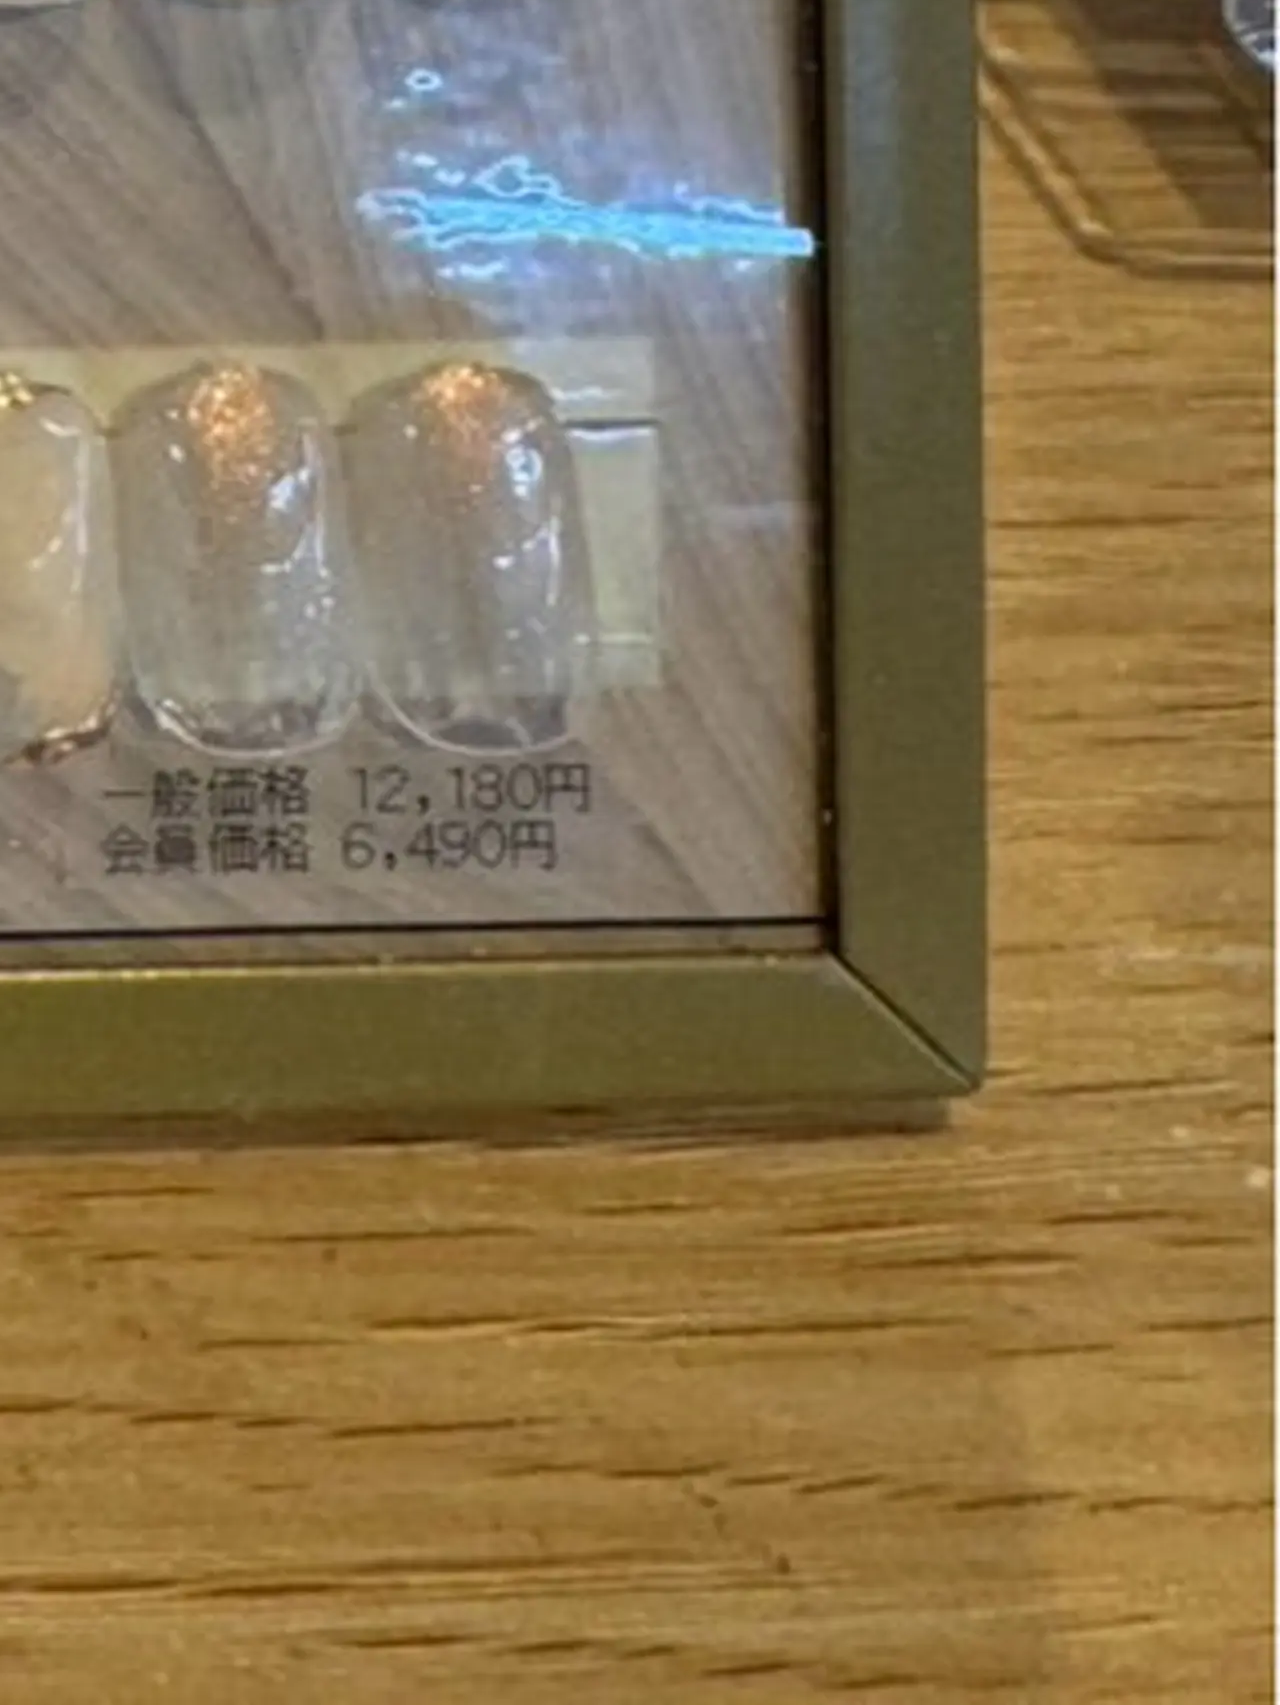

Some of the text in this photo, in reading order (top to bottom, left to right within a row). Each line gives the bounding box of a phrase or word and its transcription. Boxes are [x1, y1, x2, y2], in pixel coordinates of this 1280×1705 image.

[101, 762, 592, 818] 一般価格 12,180円
[100, 820, 558, 875] 会員価格 6,490円
